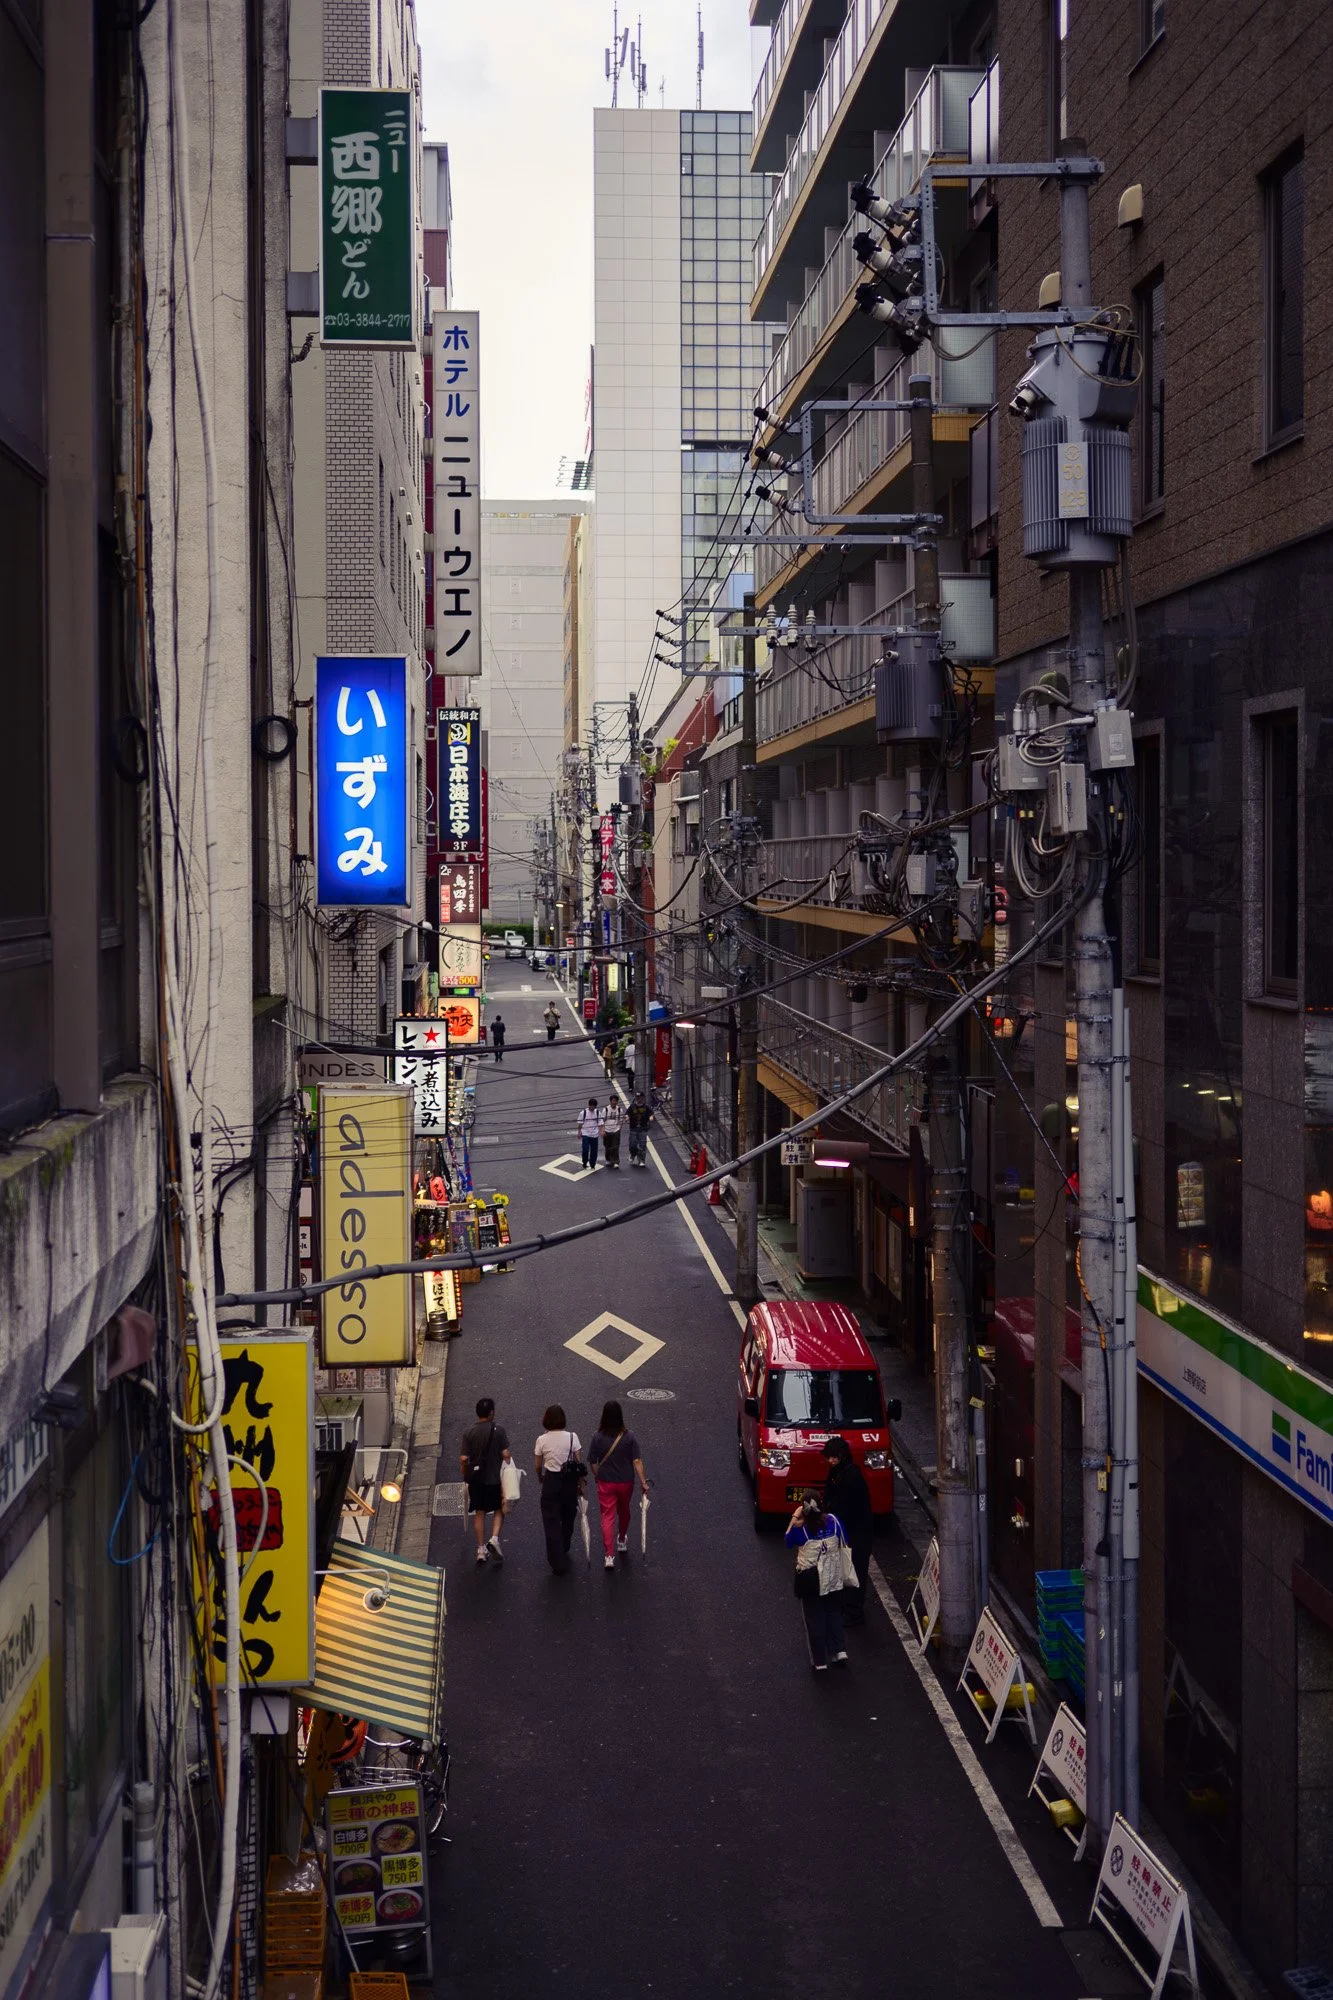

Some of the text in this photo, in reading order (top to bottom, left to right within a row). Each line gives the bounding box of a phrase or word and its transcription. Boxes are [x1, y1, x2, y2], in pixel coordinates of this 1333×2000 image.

[383, 109, 407, 174] ニュー
[330, 130, 383, 300] 西郷どん
[439, 710, 479, 721] 伝統和食
[335, 686, 389, 877] いずみ
[448, 745, 470, 839] 日本海庄や
[453, 841, 469, 851] 3F
[440, 865, 452, 876] 2F
[401, 1026, 419, 1088] レモン
[337, 1113, 404, 1345] adesso
[432, 1283, 445, 1311] ほて
[861, 1433, 880, 1442] EV
[1068, 1735, 1086, 1763] 駐輪
[350, 1792, 397, 1806] 長浜やの
[332, 1801, 417, 1822] 三種の神器
[335, 1828, 368, 1843] 白博多
[339, 1843, 366, 1855] 700円
[384, 1857, 420, 1873] 黒博多
[1131, 1854, 1172, 1913] 駐輪禁止
[339, 1897, 373, 1914] 赤博多
[341, 1913, 371, 1924] 750円
